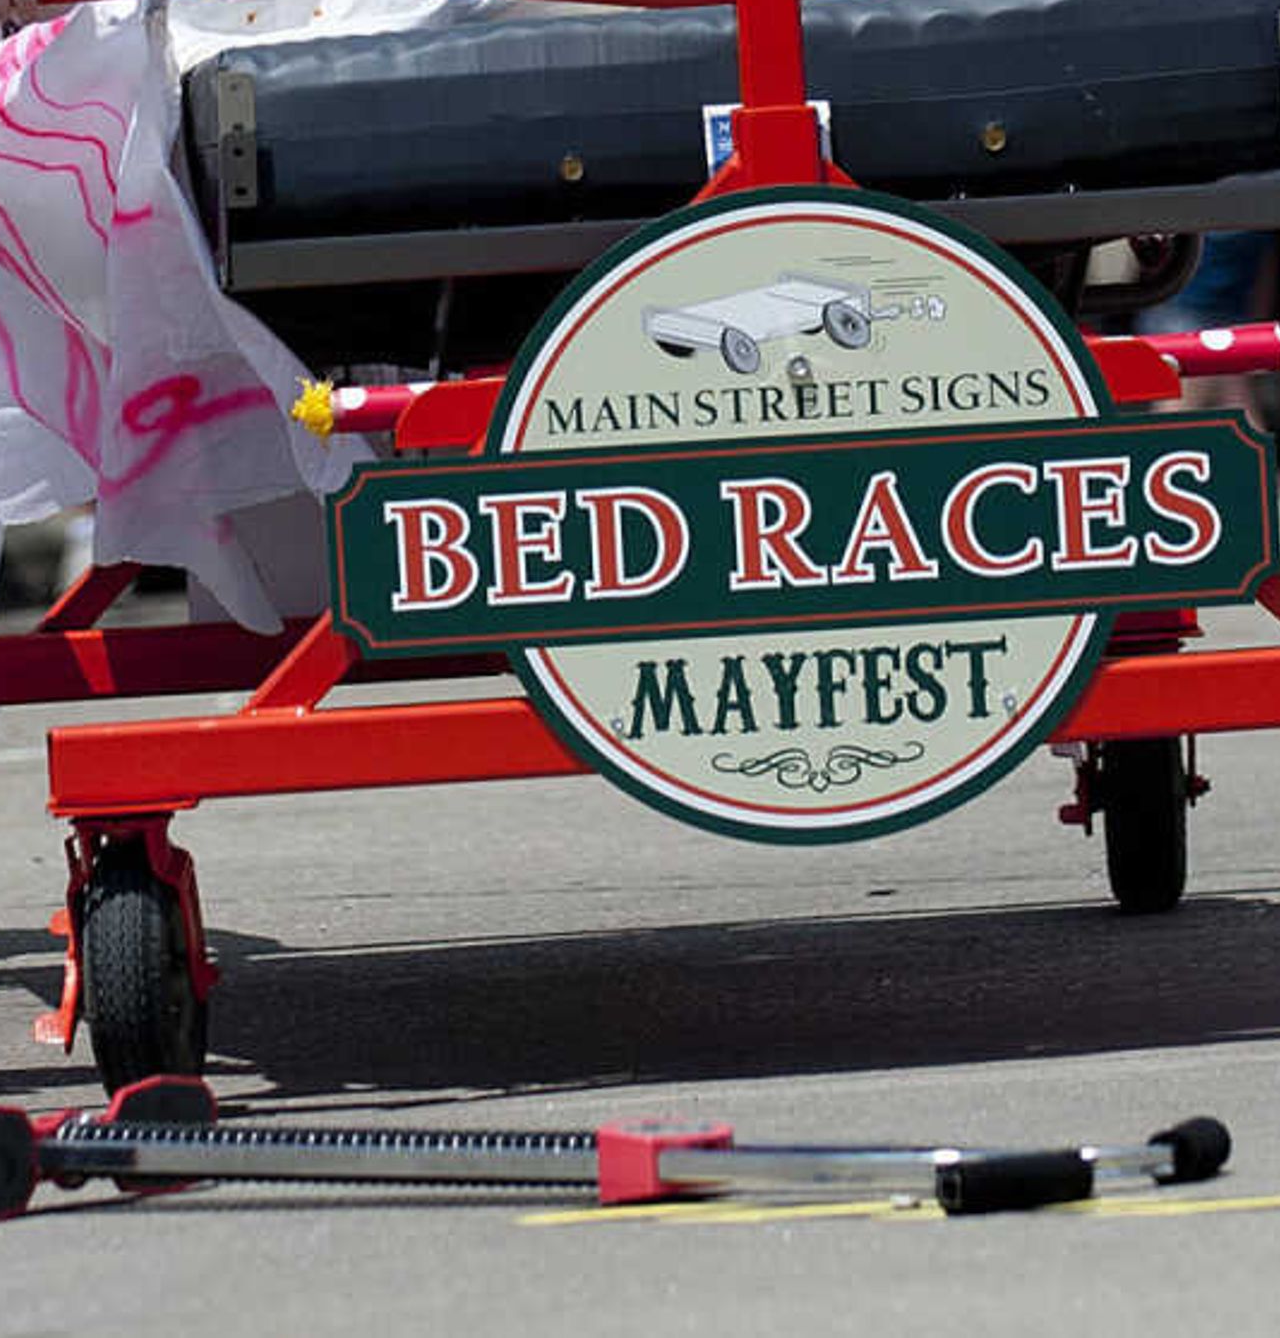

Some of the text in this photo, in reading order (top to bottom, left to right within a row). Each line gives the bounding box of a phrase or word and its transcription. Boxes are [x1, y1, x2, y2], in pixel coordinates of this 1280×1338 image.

[545, 368, 1051, 435] MAIN STREET SIGNS
[383, 450, 1223, 612] BED RACES
[627, 636, 1008, 738] MAYFEST
